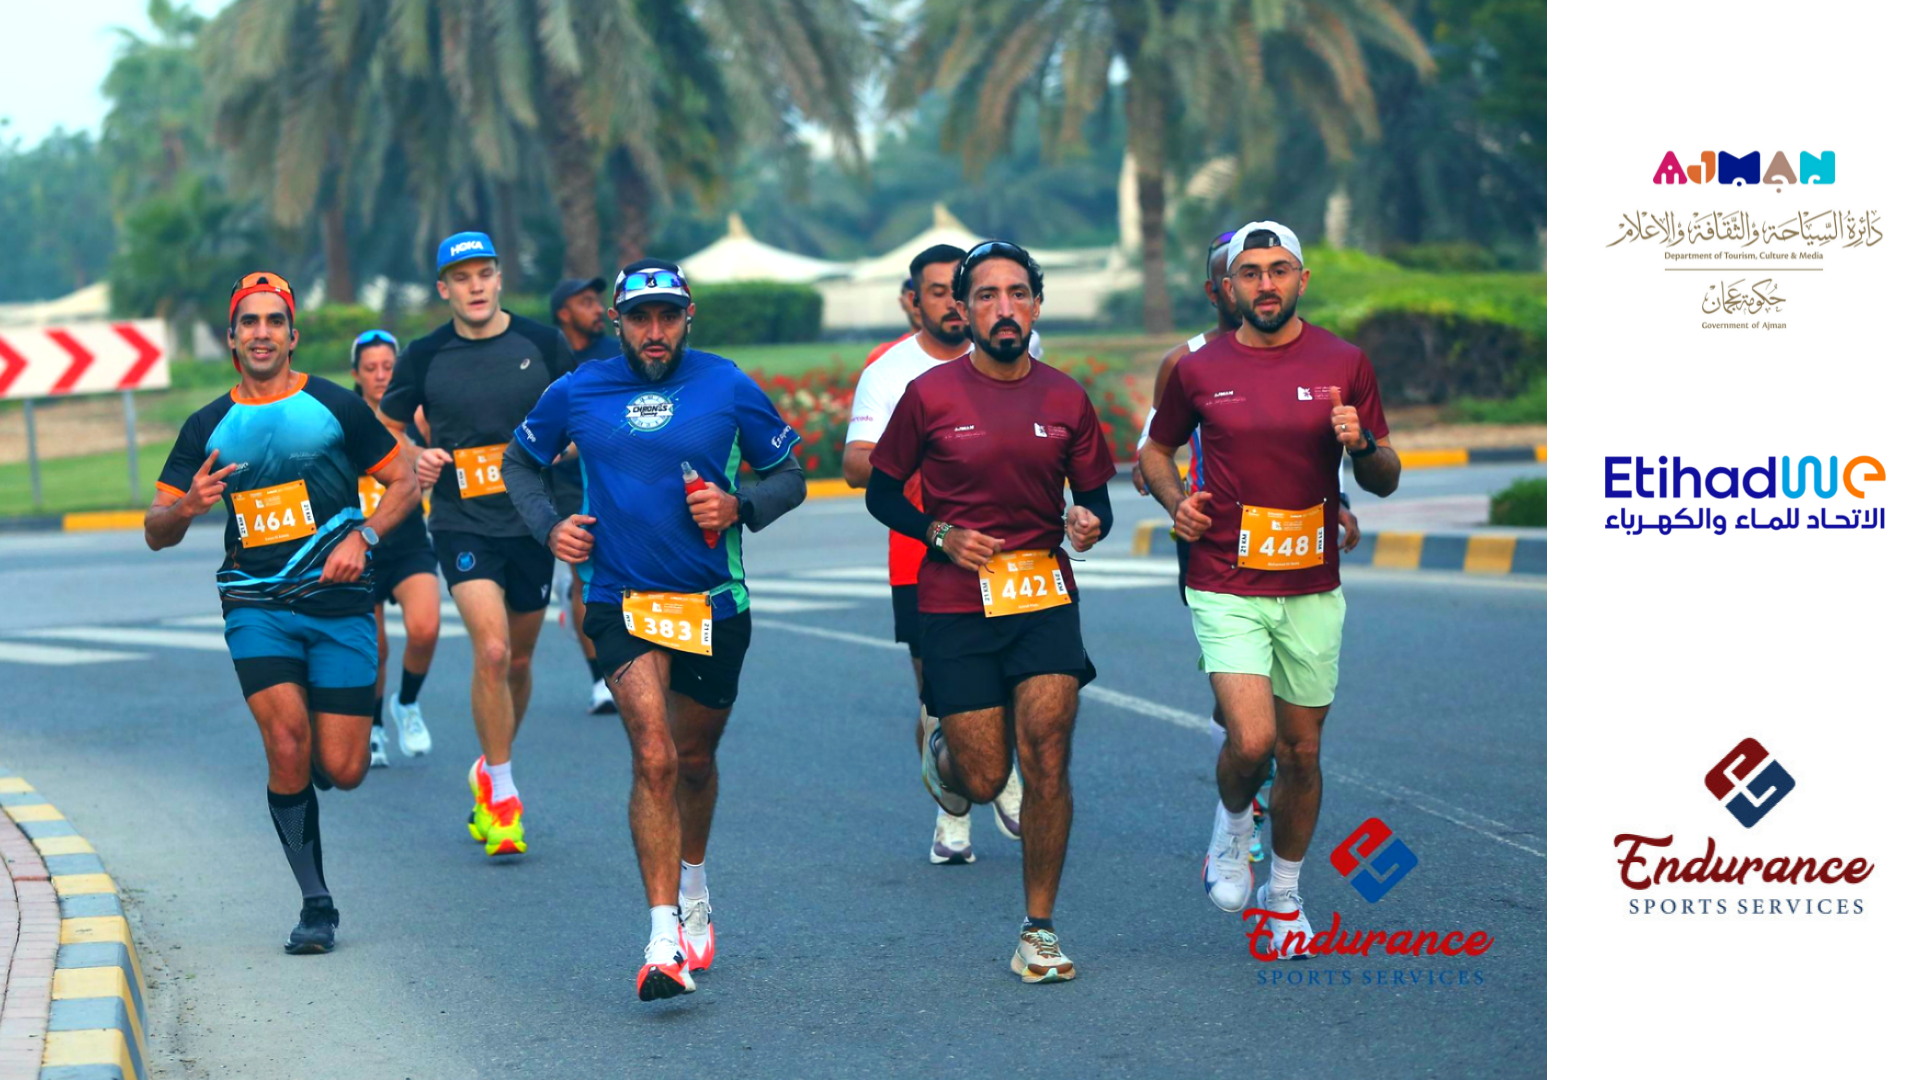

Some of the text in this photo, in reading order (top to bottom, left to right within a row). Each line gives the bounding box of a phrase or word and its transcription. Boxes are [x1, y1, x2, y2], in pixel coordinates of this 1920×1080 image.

[450, 240, 484, 257] HOKA
[475, 465, 501, 485] 18
[254, 508, 296, 533] 464
[1259, 535, 1309, 557] 448
[1002, 575, 1048, 599] 442
[644, 617, 692, 641] 383
